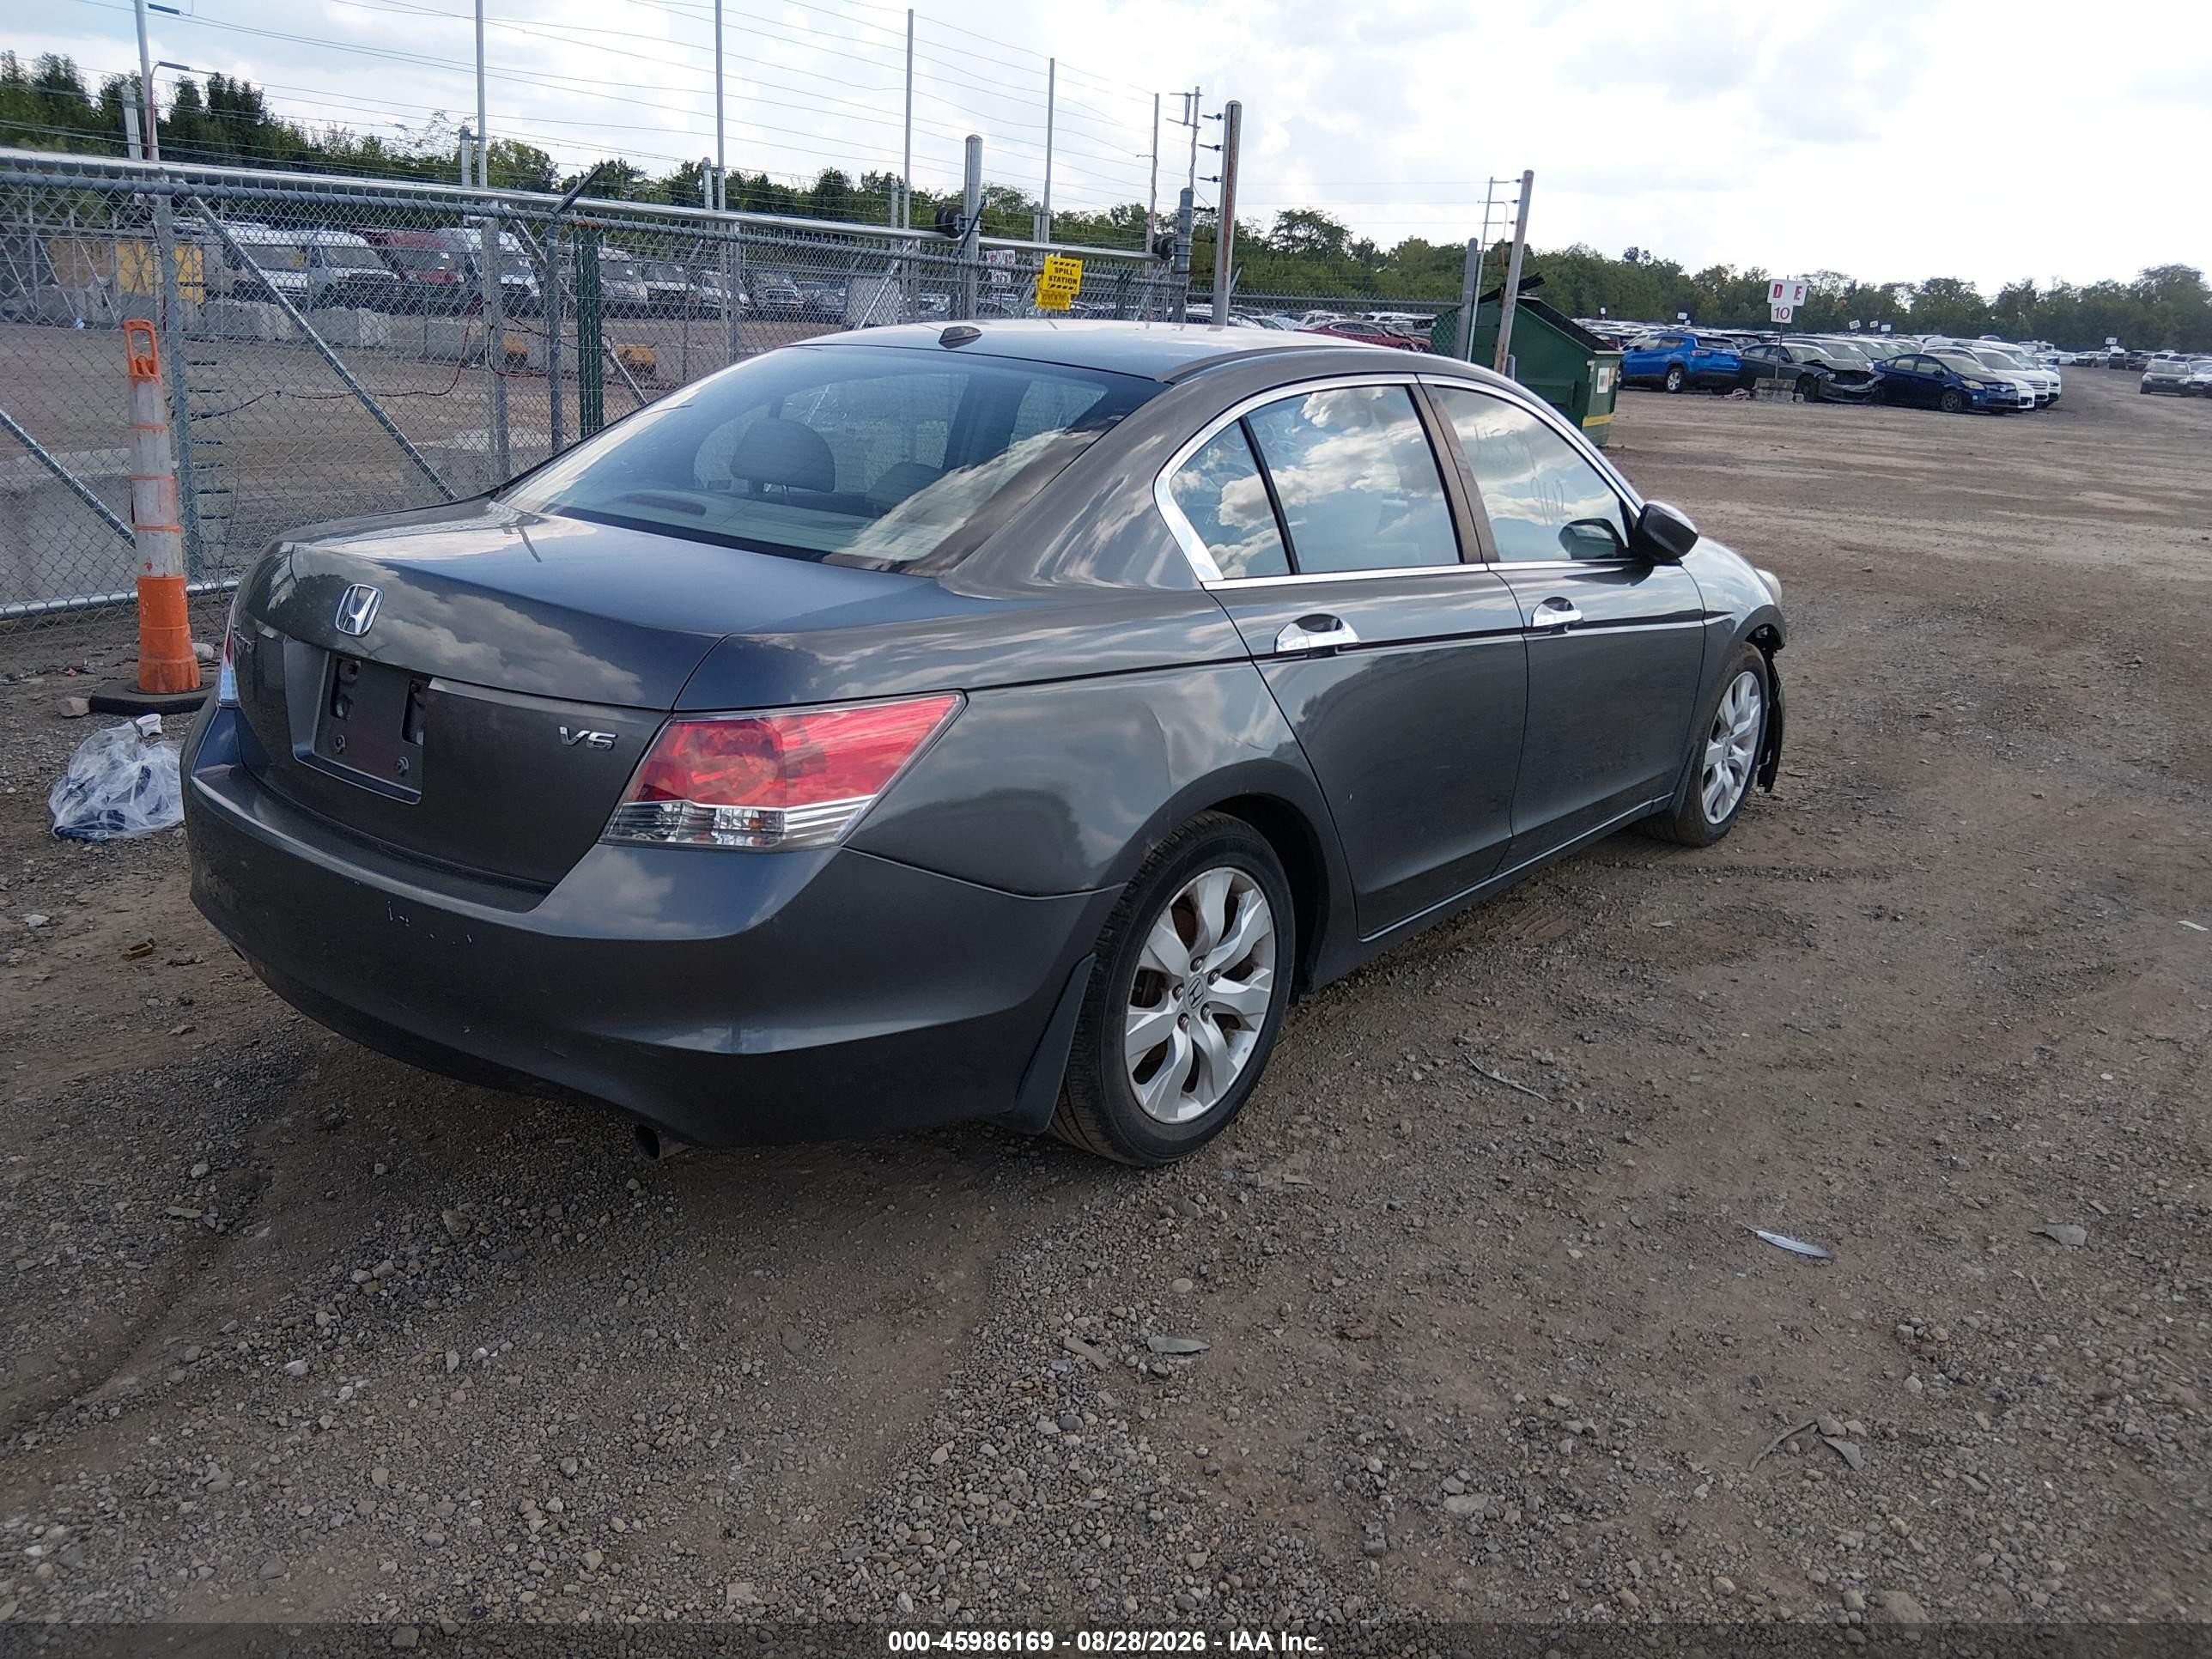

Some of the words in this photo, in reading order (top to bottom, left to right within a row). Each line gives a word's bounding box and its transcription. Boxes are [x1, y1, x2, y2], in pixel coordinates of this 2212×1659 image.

[1054, 267, 1073, 276] SPILL
[1048, 276, 1078, 285] STATION
[1772, 283, 1784, 299] D
[1793, 285, 1803, 301] E
[1774, 307, 1790, 319] 10
[559, 726, 618, 750] V6
